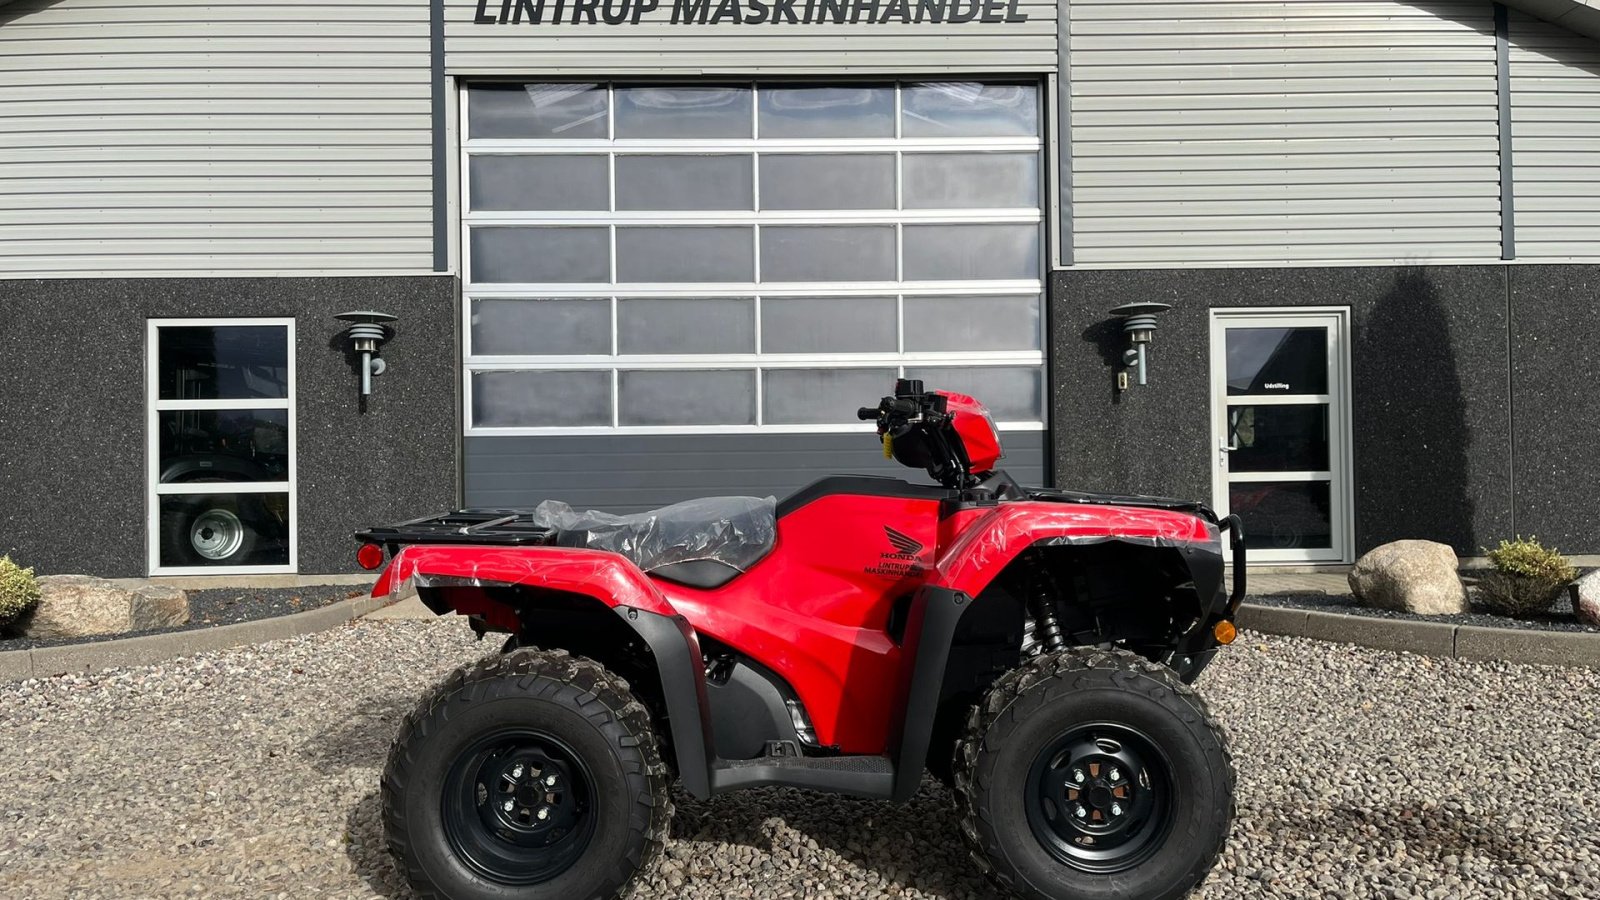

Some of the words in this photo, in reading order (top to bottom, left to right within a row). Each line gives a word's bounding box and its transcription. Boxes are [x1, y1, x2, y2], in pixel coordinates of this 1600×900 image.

[474, 0, 659, 25] LINTRUP
[669, 0, 1029, 25] MASKINHANDEL
[880, 553, 922, 562] HONDA
[879, 562, 911, 570] LINTRUP
